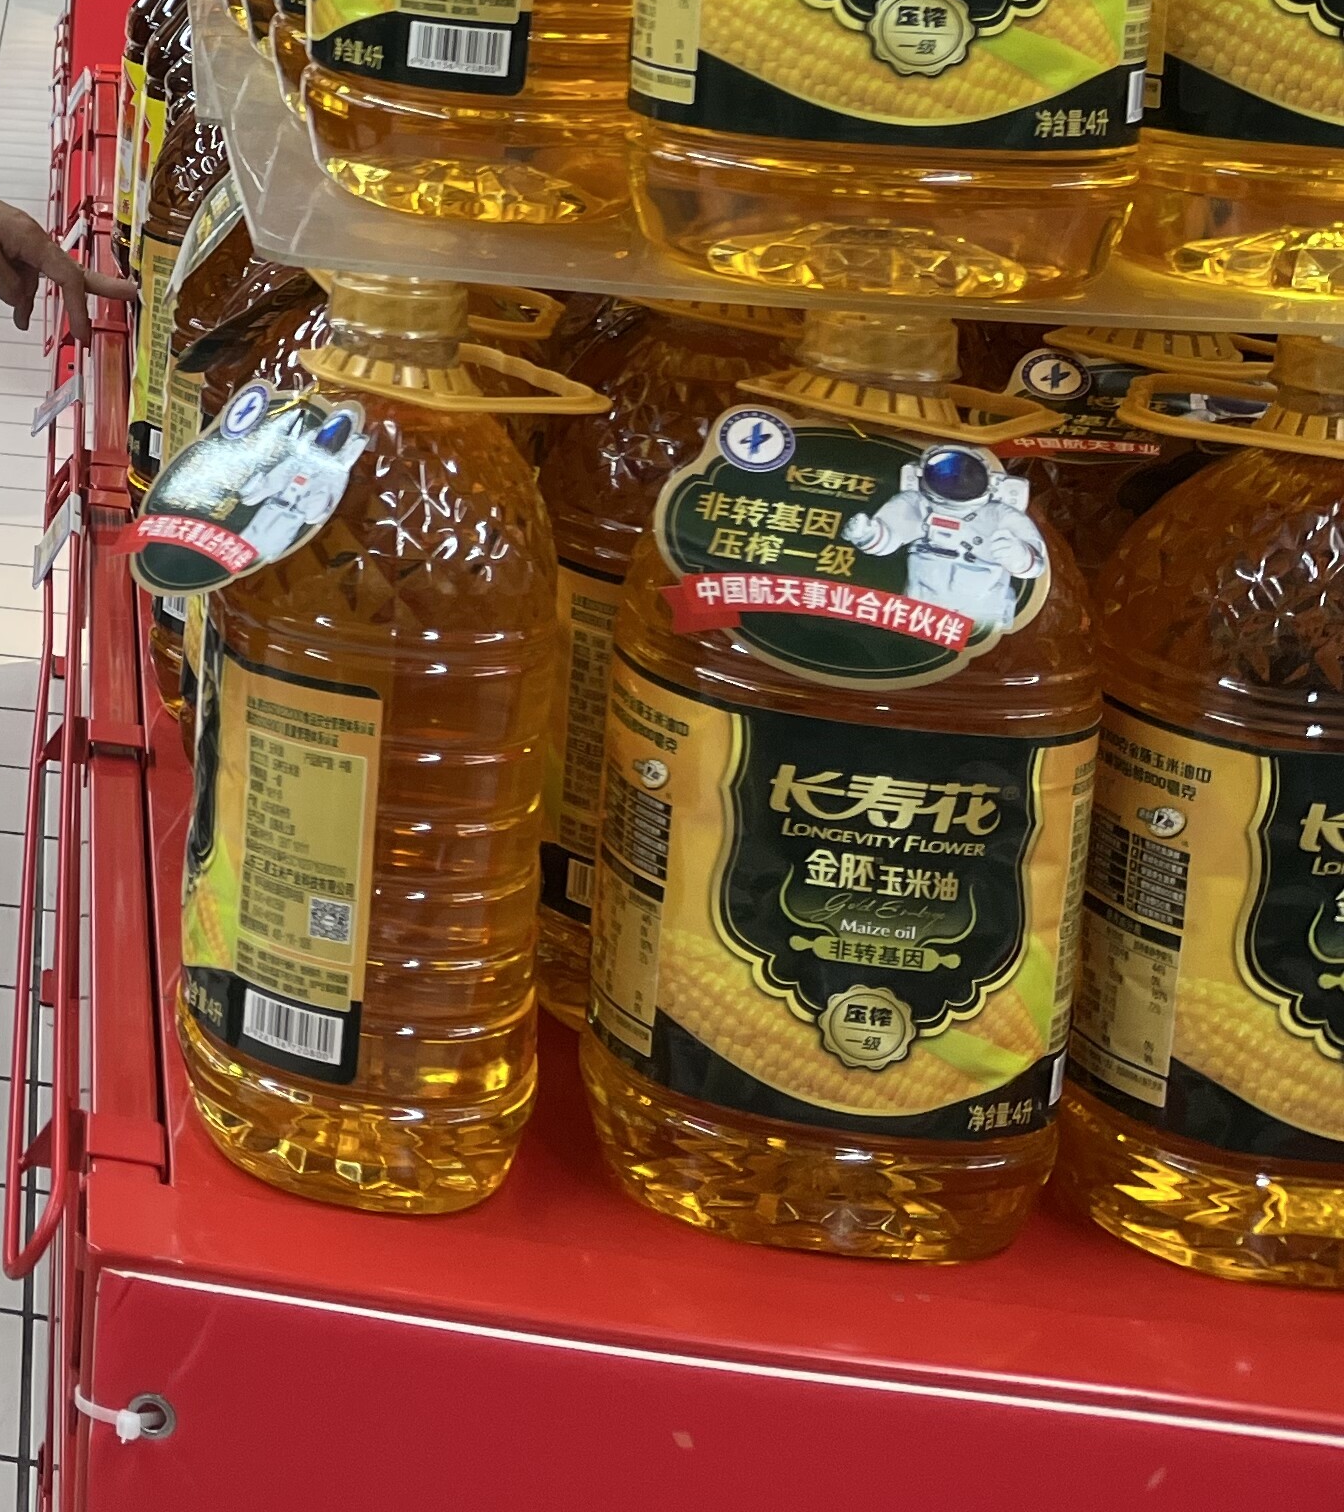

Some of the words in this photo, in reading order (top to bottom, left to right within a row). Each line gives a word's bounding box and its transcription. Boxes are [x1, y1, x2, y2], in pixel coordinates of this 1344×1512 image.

[895, 6, 948, 29] 压榨
[897, 38, 937, 55] 一级
[786, 465, 877, 495] 长寿花
[694, 492, 843, 540] 非转基因
[707, 528, 856, 578] 压榨一级
[694, 576, 965, 648] 中国航天事业合作伙伴
[769, 763, 1002, 837] 长寿花
[781, 817, 900, 850] LONGEVITY
[904, 833, 986, 857] FLOWER
[805, 849, 959, 901] 金胚玉米油
[1311, 856, 1344, 876] LO
[840, 918, 892, 938] Maize
[894, 924, 917, 939] oil
[830, 940, 925, 969] 非转基因
[843, 1004, 893, 1027] 压榨
[844, 1035, 881, 1051] 一级
